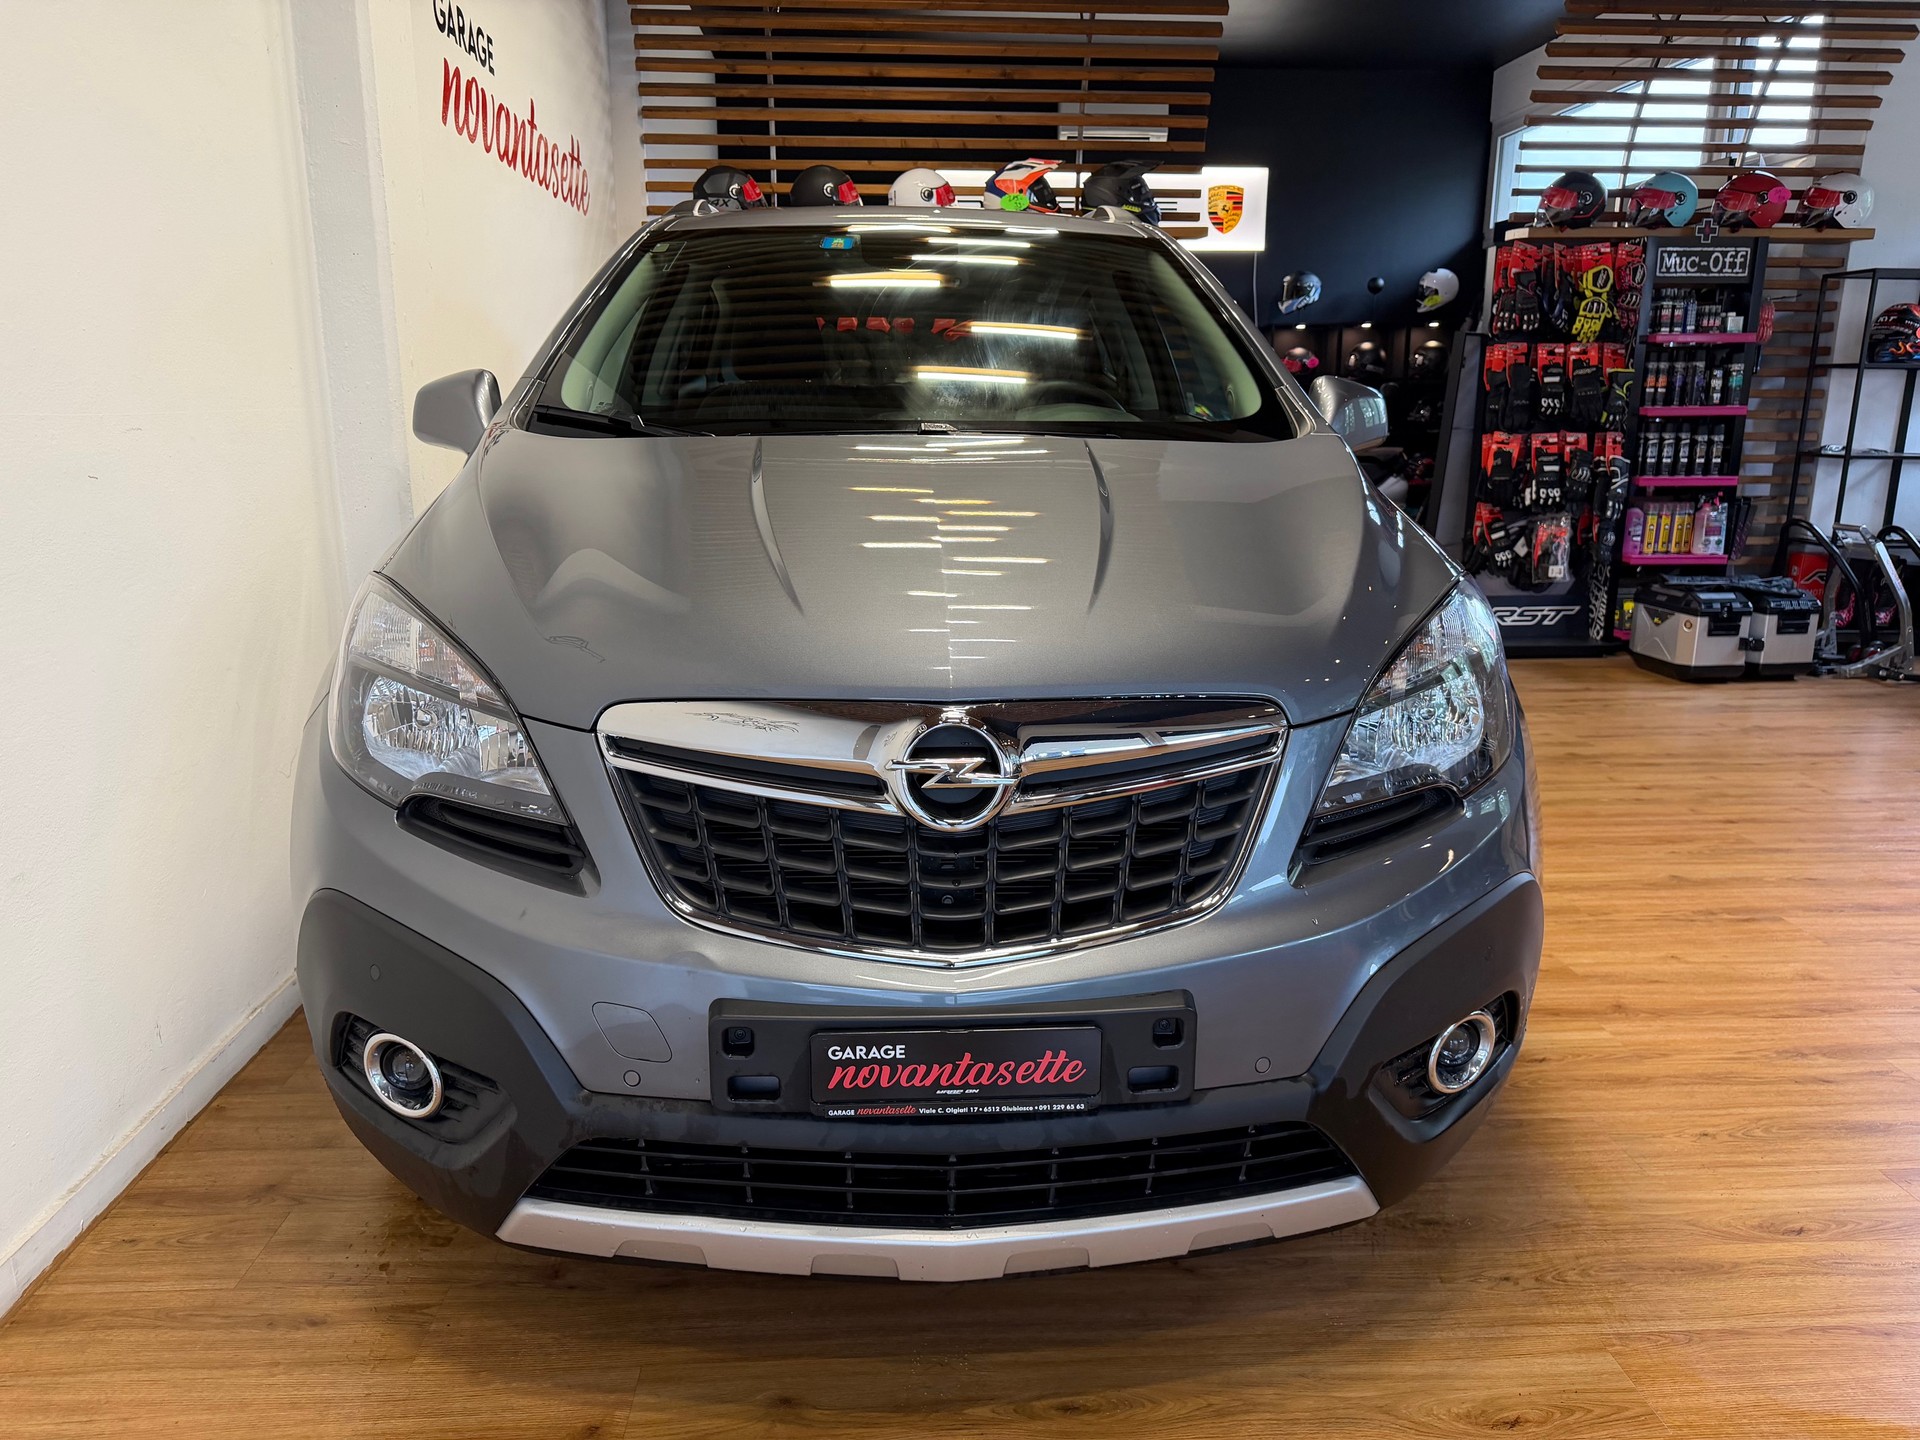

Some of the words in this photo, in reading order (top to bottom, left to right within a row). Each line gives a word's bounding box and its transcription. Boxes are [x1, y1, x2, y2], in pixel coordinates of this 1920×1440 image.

[433, 0, 495, 76] GARAGE
[441, 56, 590, 216] novantasette
[1660, 251, 1746, 273] Muc-Off
[1493, 605, 1581, 626] RST
[827, 1044, 906, 1060] GARAGE
[827, 1049, 1087, 1090] novantasette
[856, 1105, 918, 1116] novantasette
[945, 1106, 968, 1115] Olgiati
[983, 1105, 1000, 1113] 6512
